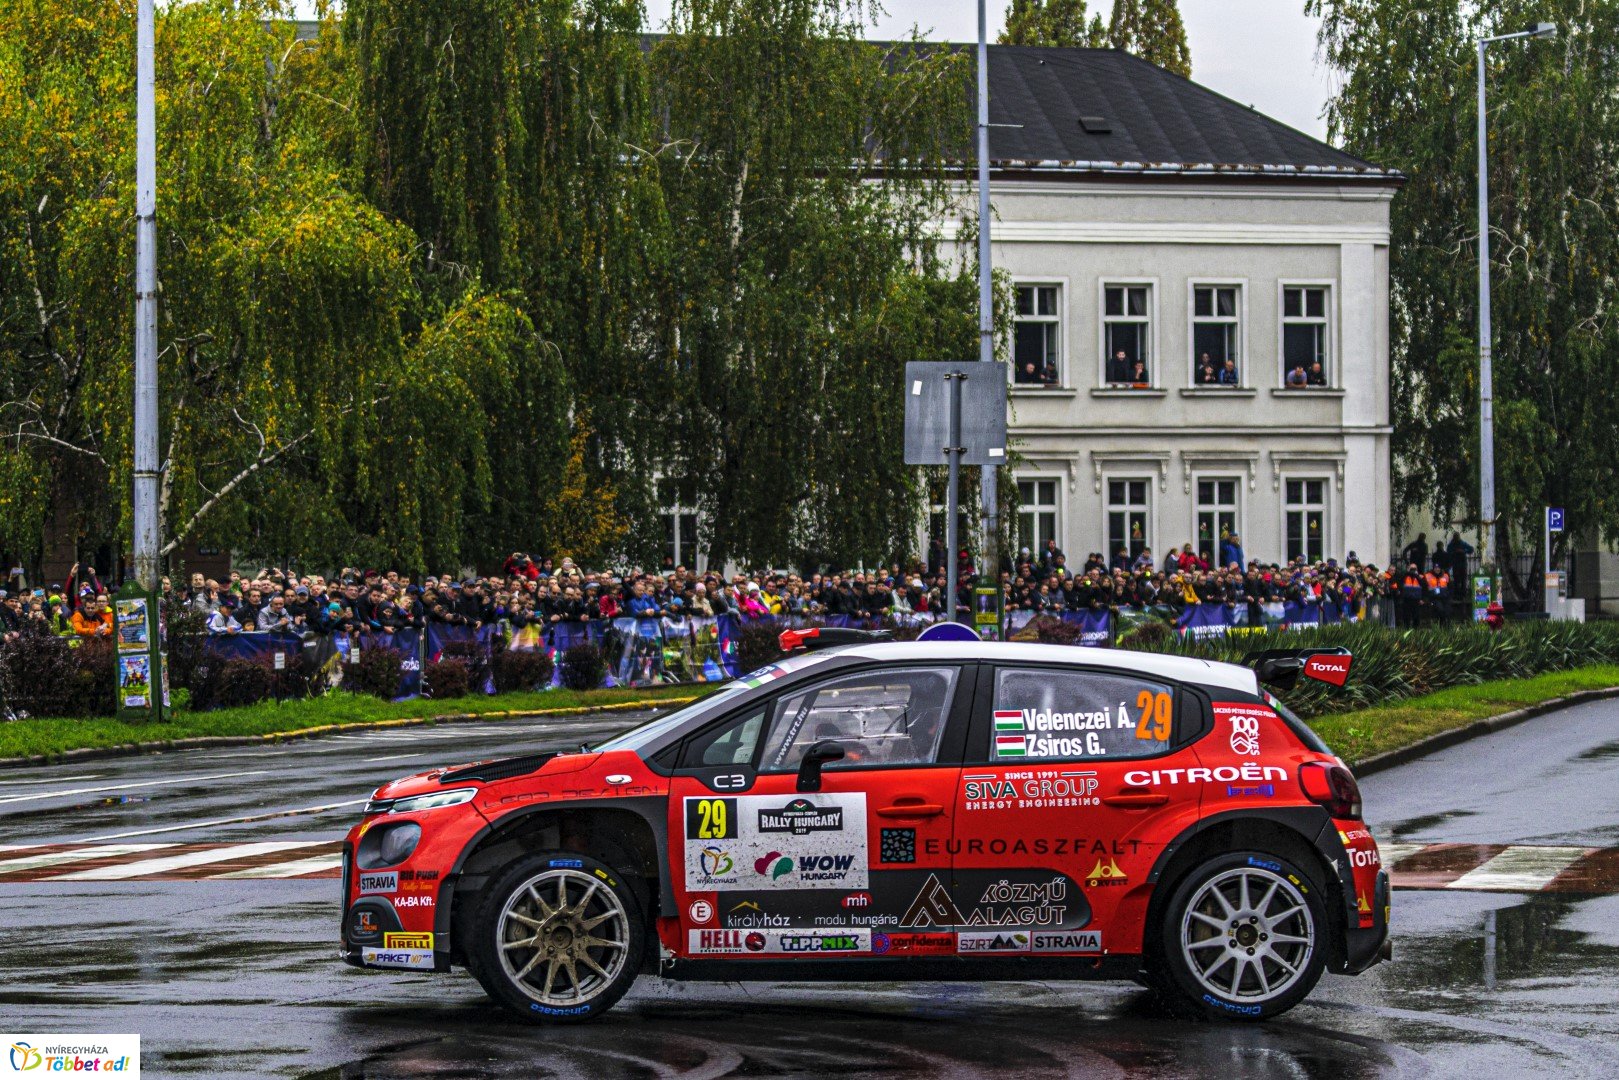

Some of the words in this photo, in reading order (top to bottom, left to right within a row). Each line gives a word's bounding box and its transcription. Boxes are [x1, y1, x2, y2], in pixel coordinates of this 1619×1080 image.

[1551, 511, 1561, 525] P
[1311, 662, 1346, 672] TOTAL
[1023, 707, 1111, 731] Velenczei
[1118, 702, 1136, 729] Á.
[1135, 690, 1172, 741] 29
[1229, 715, 1259, 733] 100
[1026, 733, 1082, 756] Zsiros
[1086, 732, 1106, 755] G.
[714, 774, 745, 788] C3
[1005, 772, 1033, 780] SINCE
[1037, 771, 1058, 779] 1991
[1124, 762, 1288, 786] CITROËN
[965, 780, 1018, 799] SIVA
[1023, 778, 1098, 797] GROUP
[966, 800, 1012, 810] ENERGY
[1019, 797, 1100, 808] ENGINEERING
[698, 800, 727, 839] 29
[761, 814, 791, 828] RALLY
[794, 812, 841, 827] HUNGARY
[925, 839, 1142, 855] EUROASZFALT
[800, 855, 854, 871] WOW
[362, 876, 396, 890] STRAVIA
[801, 872, 847, 880] HUNGARY
[981, 877, 1066, 903] KÖZMŰ
[394, 896, 419, 907] KA-BA
[420, 896, 435, 907] Kft.
[847, 894, 867, 906] mh
[696, 906, 706, 917] E
[966, 902, 1066, 926] ALAGÚT
[727, 913, 790, 928] királyház
[815, 914, 846, 925] modu
[851, 913, 898, 927] hungária
[387, 934, 430, 949] PIRELLI
[701, 930, 742, 948] HELL
[892, 935, 952, 946] confidenza
[961, 939, 994, 950] SZIRT
[1035, 936, 1098, 948] STRAVIA
[377, 953, 411, 963] PAKET
